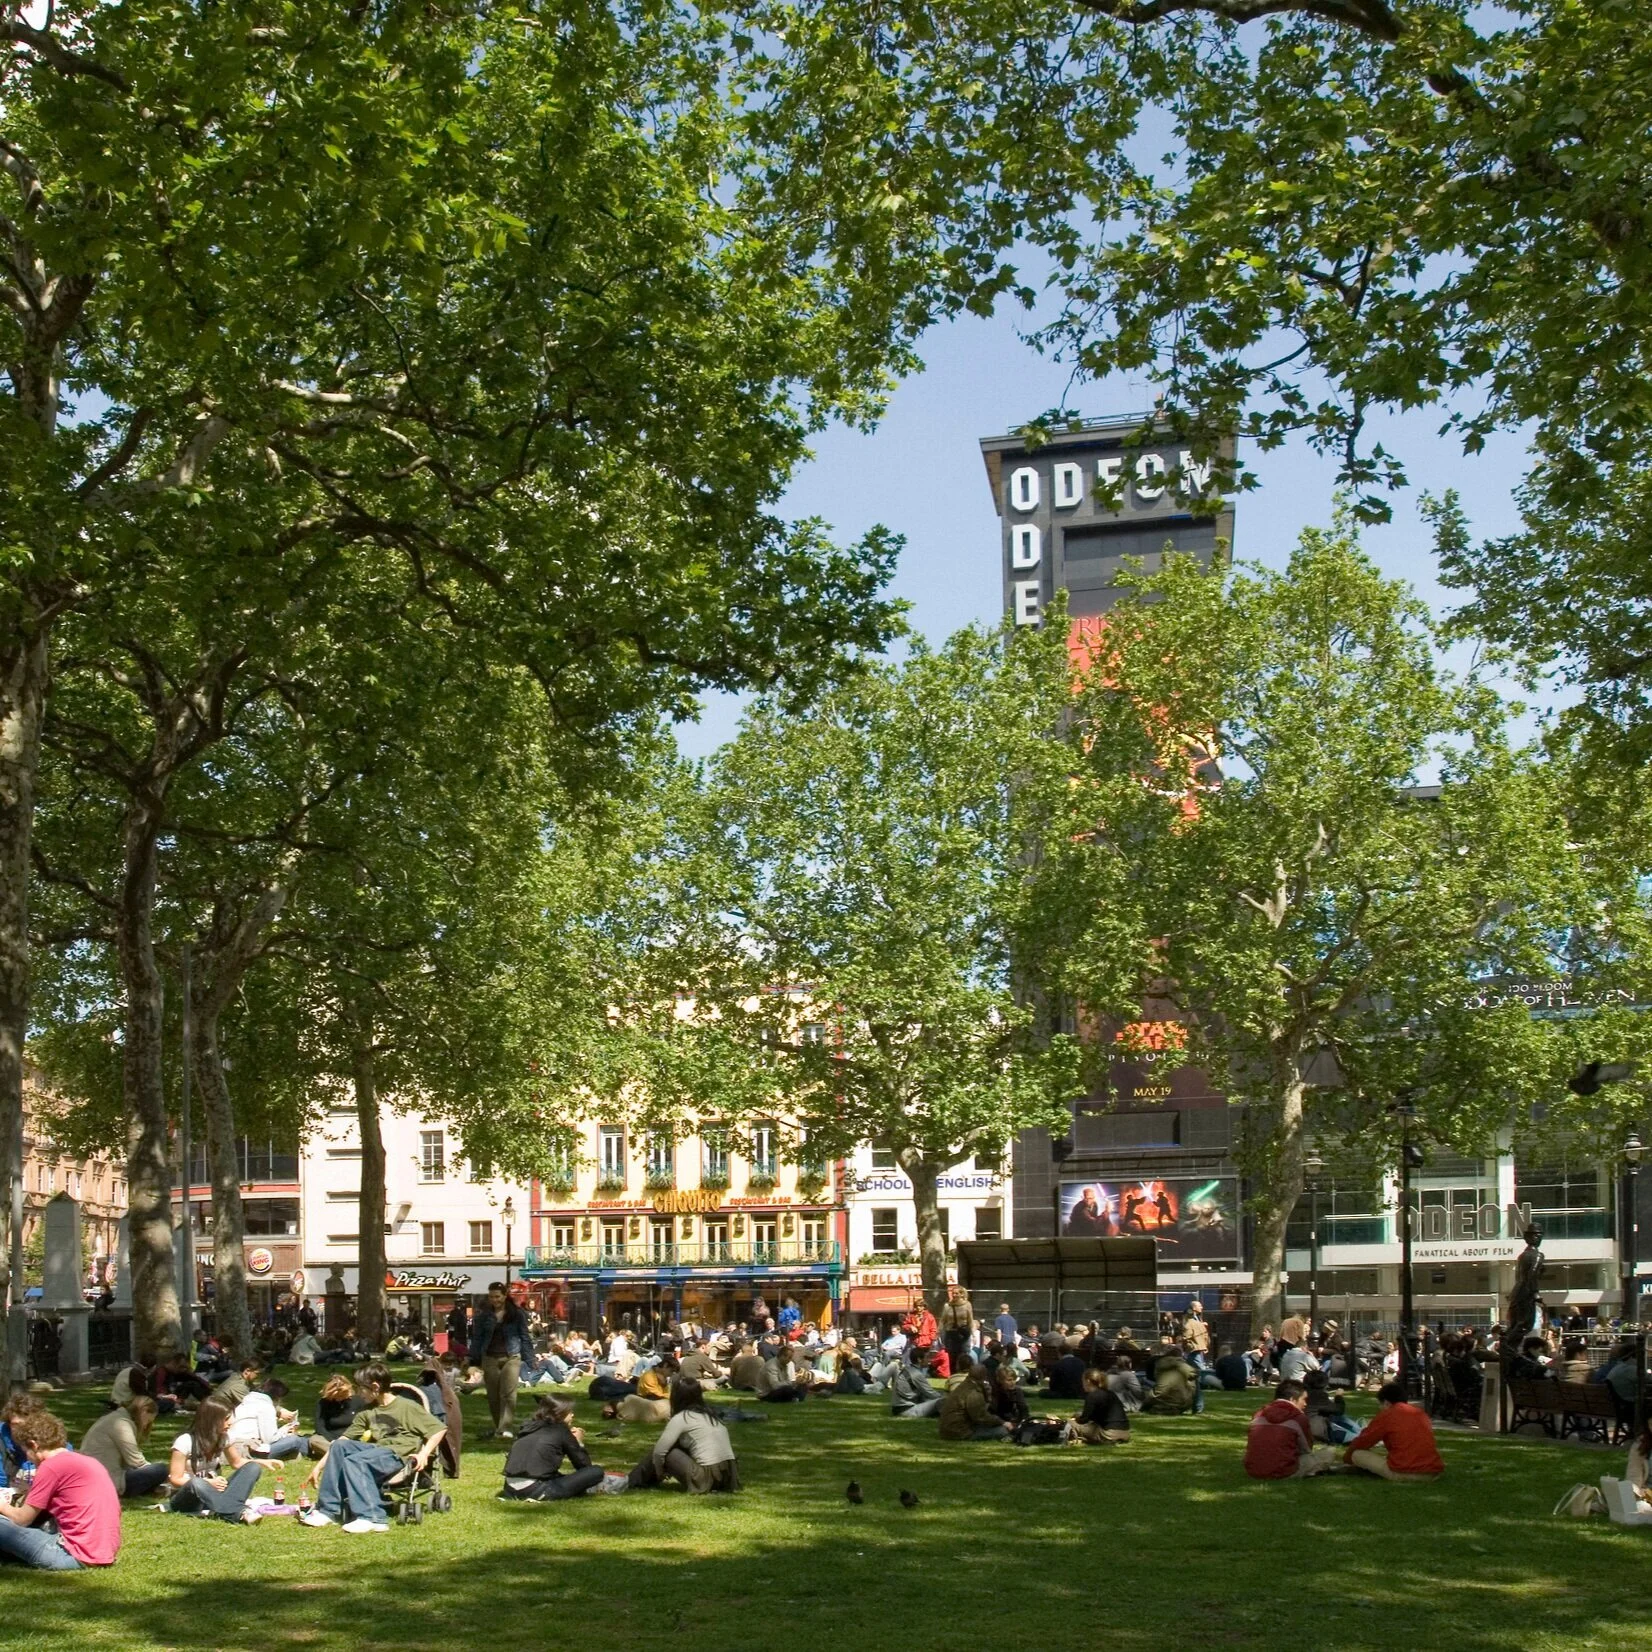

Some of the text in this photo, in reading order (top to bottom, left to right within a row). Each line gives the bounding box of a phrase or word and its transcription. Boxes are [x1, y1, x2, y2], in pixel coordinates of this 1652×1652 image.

[1011, 450, 1211, 512] ODEON
[1133, 1086, 1172, 1097] MAY 19
[856, 1177, 994, 1190] SCHOOL ENGLISH
[654, 1189, 721, 1213] CHIQUITO
[1396, 1202, 1532, 1241] ODEON
[1414, 1247, 1514, 1257] FANATICAL ABOUT FILM
[394, 1271, 471, 1287] Pizza Hut
[862, 1273, 908, 1285] BELLA
